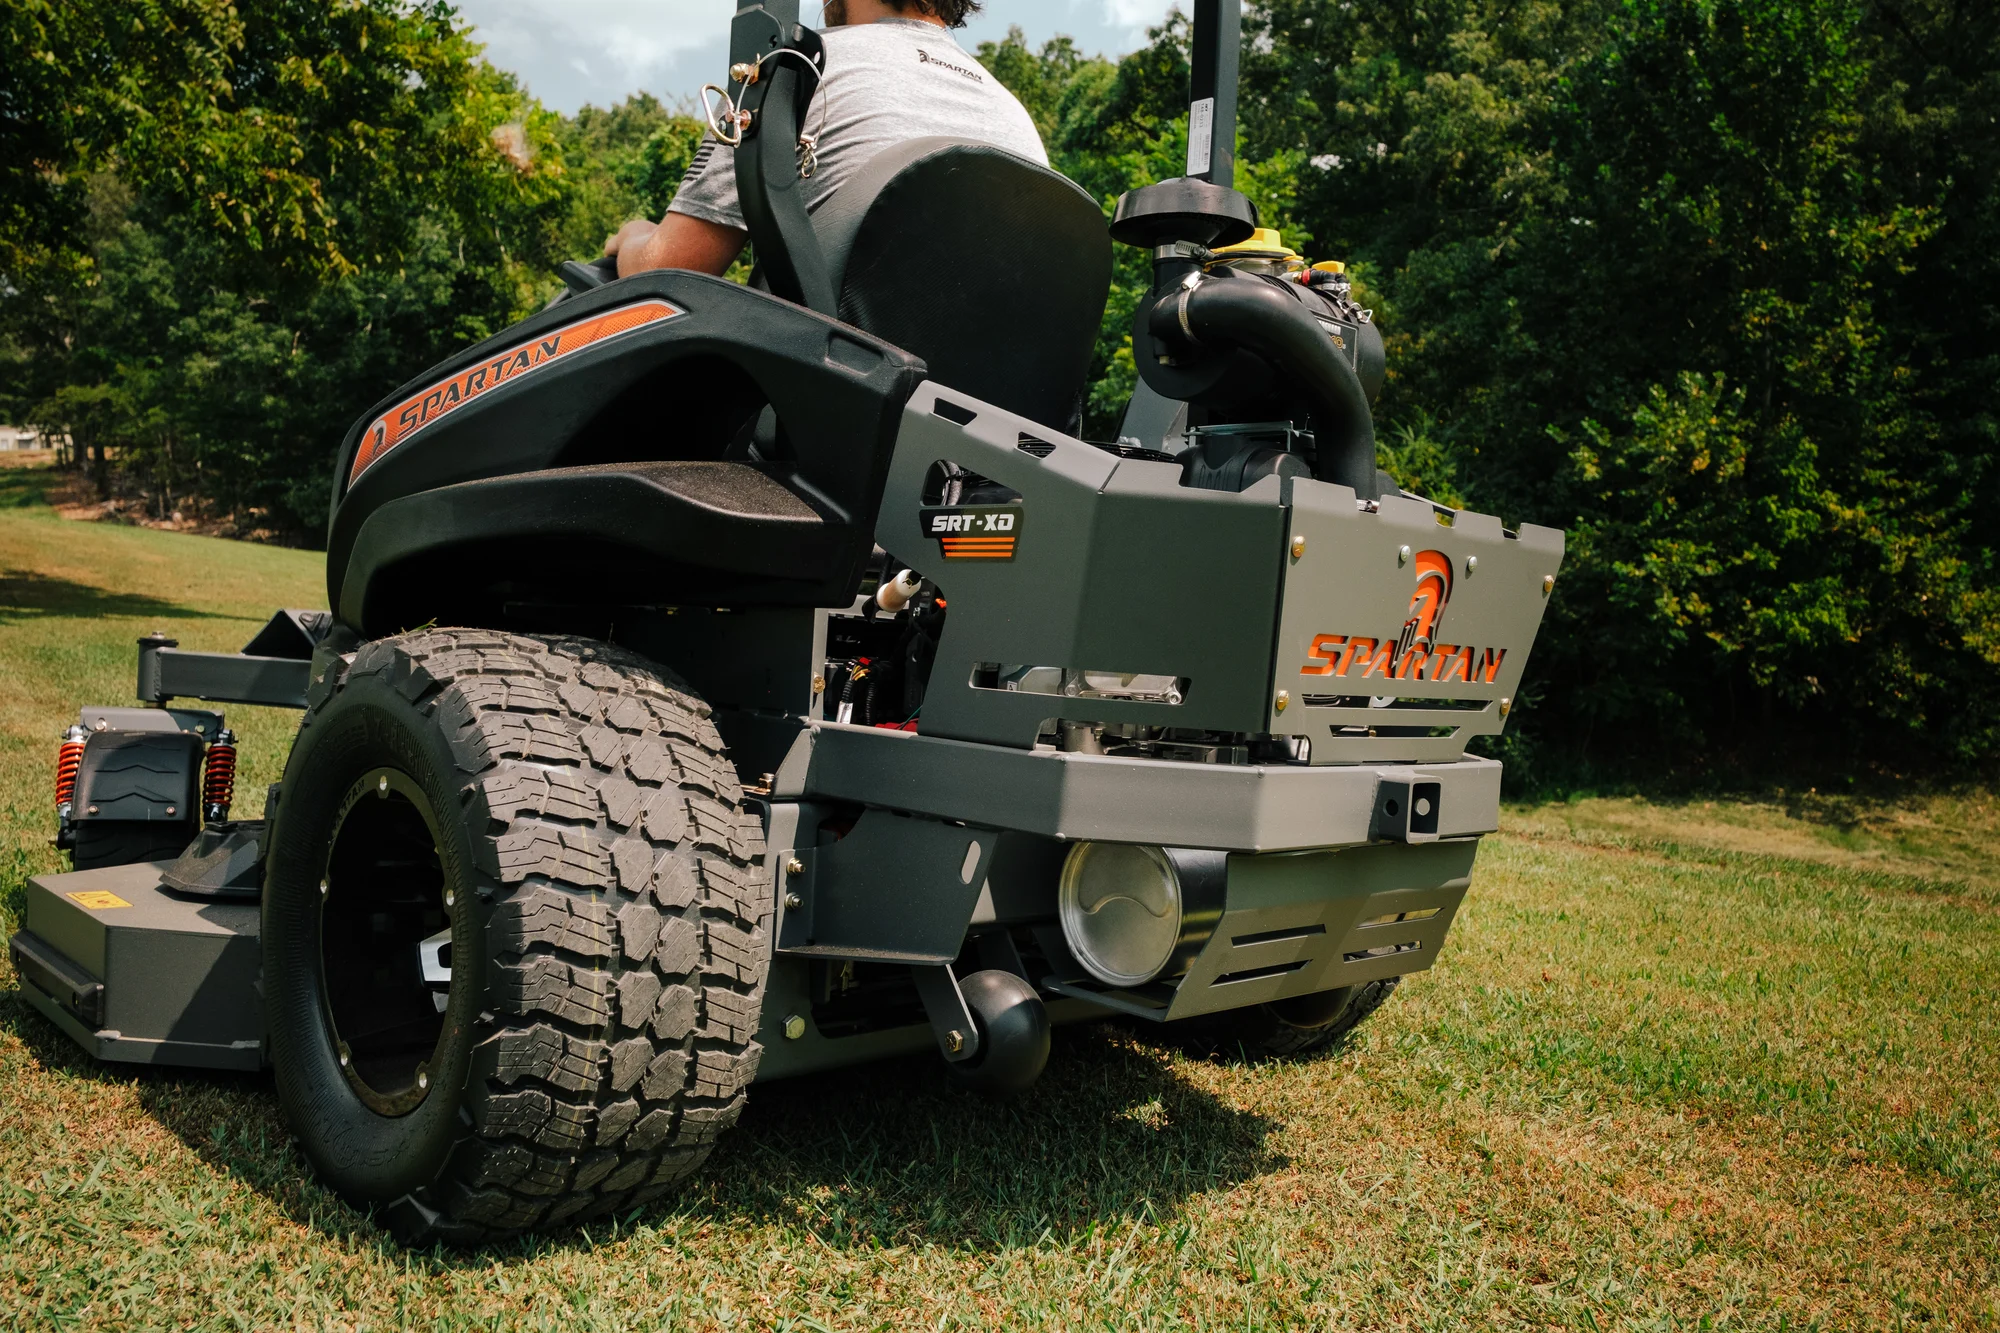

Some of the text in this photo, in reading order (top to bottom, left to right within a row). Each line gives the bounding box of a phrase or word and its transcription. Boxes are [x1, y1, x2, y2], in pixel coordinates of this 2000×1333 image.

[930, 57, 983, 81] SPARTAN
[397, 336, 561, 438] SPARTAN
[931, 513, 1015, 532] SRT-XD
[1300, 633, 1507, 684] SPARTAN
